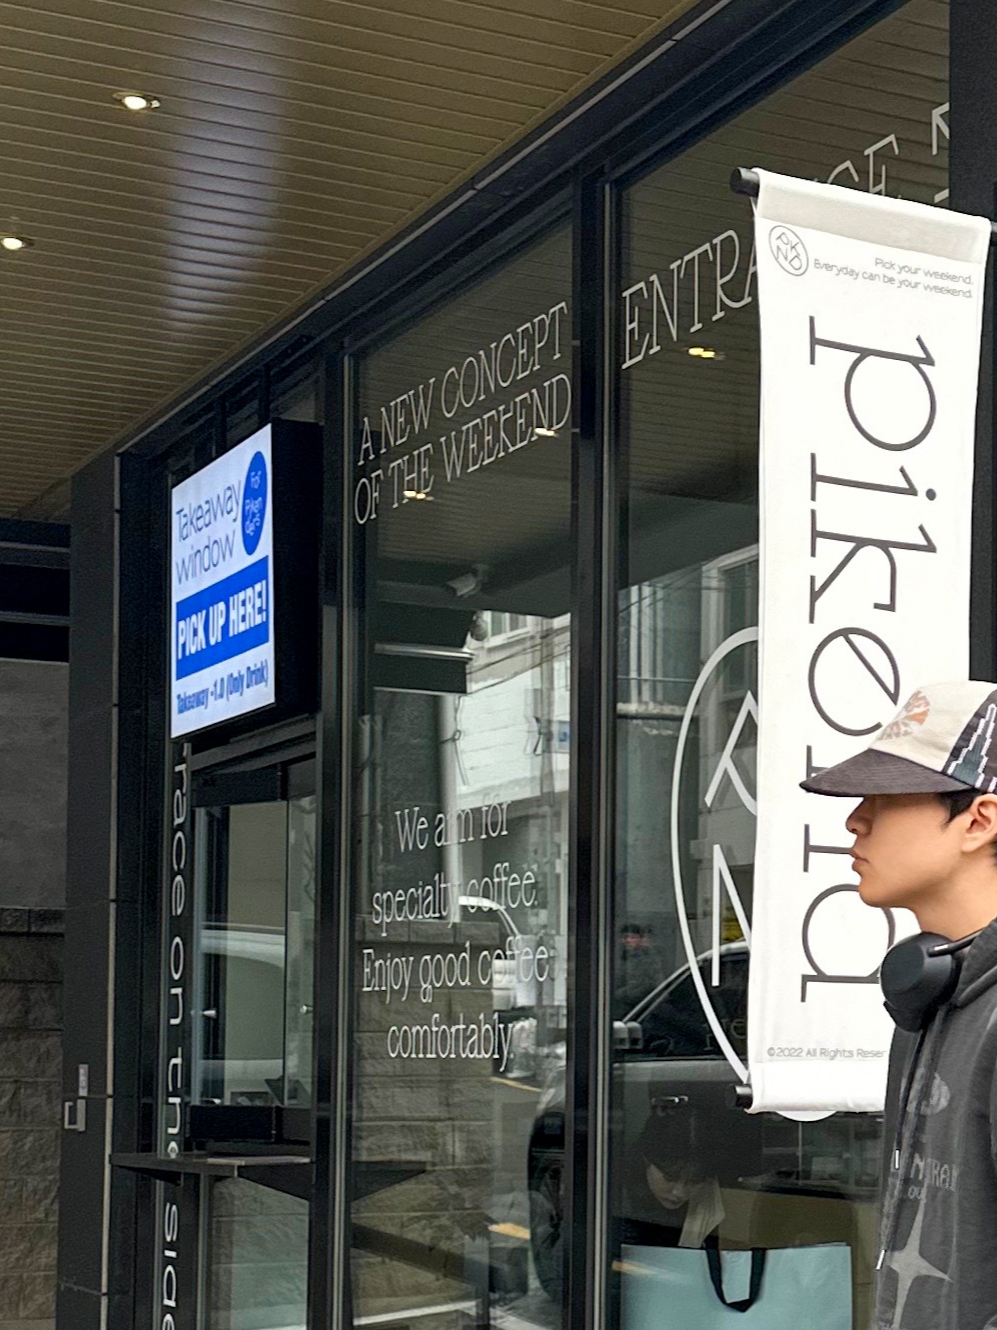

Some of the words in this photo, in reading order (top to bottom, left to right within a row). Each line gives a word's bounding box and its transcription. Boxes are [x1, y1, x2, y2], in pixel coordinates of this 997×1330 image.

[813, 258, 860, 282] Everyday
[861, 270, 881, 283] can
[882, 273, 896, 286] be
[897, 276, 921, 289] your
[875, 258, 896, 271] Pick
[897, 263, 921, 276] your
[357, 416, 375, 466] A
[379, 377, 436, 454] NEW
[440, 301, 568, 418] CONCEPT
[354, 469, 384, 525] OF
[388, 443, 434, 508] THE
[439, 373, 572, 482] WEEKEND
[176, 480, 241, 542] Takeaway
[176, 530, 236, 584] window
[178, 609, 207, 660] PICK
[209, 601, 226, 646] UP
[229, 580, 266, 637] HERE!
[800, 315, 937, 1004] piked
[177, 687, 209, 715] Takeaway
[395, 806, 428, 852] We
[372, 872, 461, 937] specialty
[466, 862, 538, 913] coffee.
[169, 936, 184, 1025] on
[362, 948, 414, 1004] Enjoy
[419, 940, 470, 1003] good
[387, 1013, 515, 1073] comfortably.
[805, 1048, 818, 1058] All
[819, 1048, 853, 1060] Rights
[856, 1049, 887, 1058] Reser
